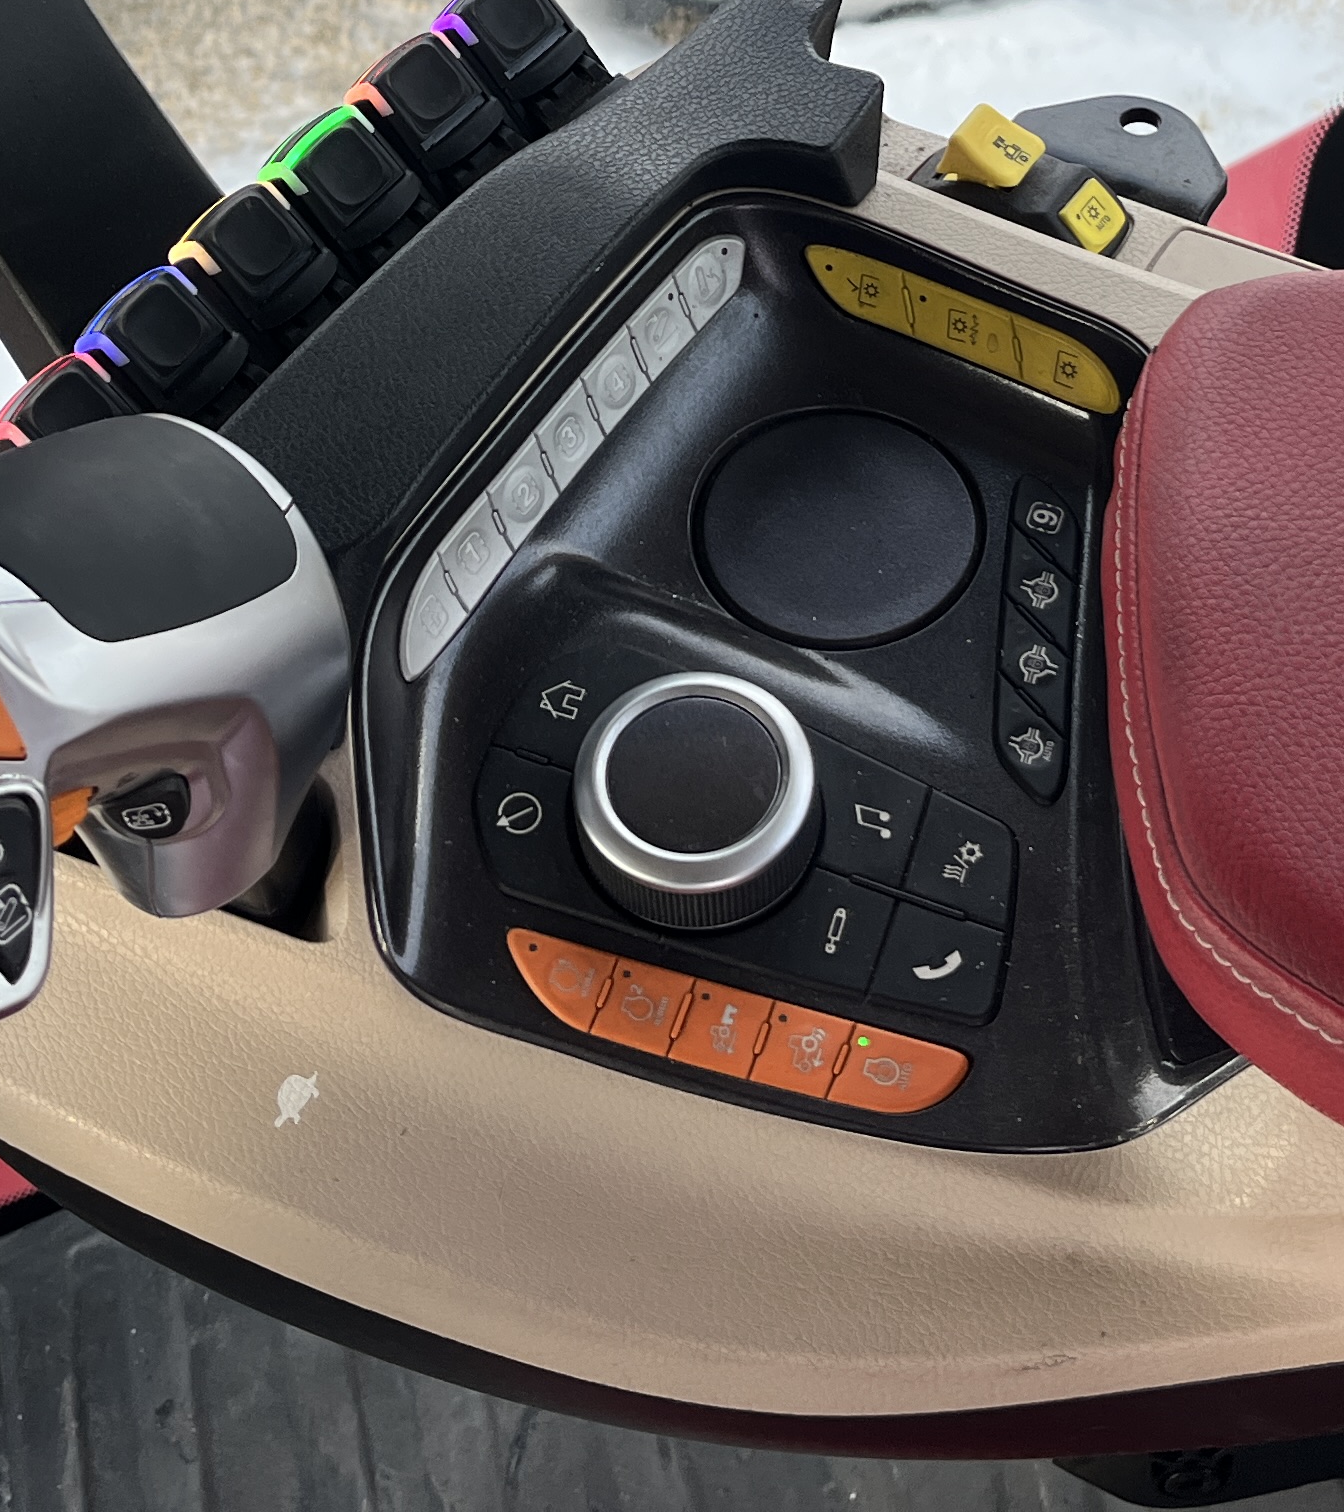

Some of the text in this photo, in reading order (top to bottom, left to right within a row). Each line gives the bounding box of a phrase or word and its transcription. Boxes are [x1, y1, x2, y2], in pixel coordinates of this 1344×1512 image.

[1096, 215, 1111, 231] AUTO
[562, 426, 577, 448] 3
[519, 483, 534, 506] 2
[1041, 741, 1055, 762] AUTO
